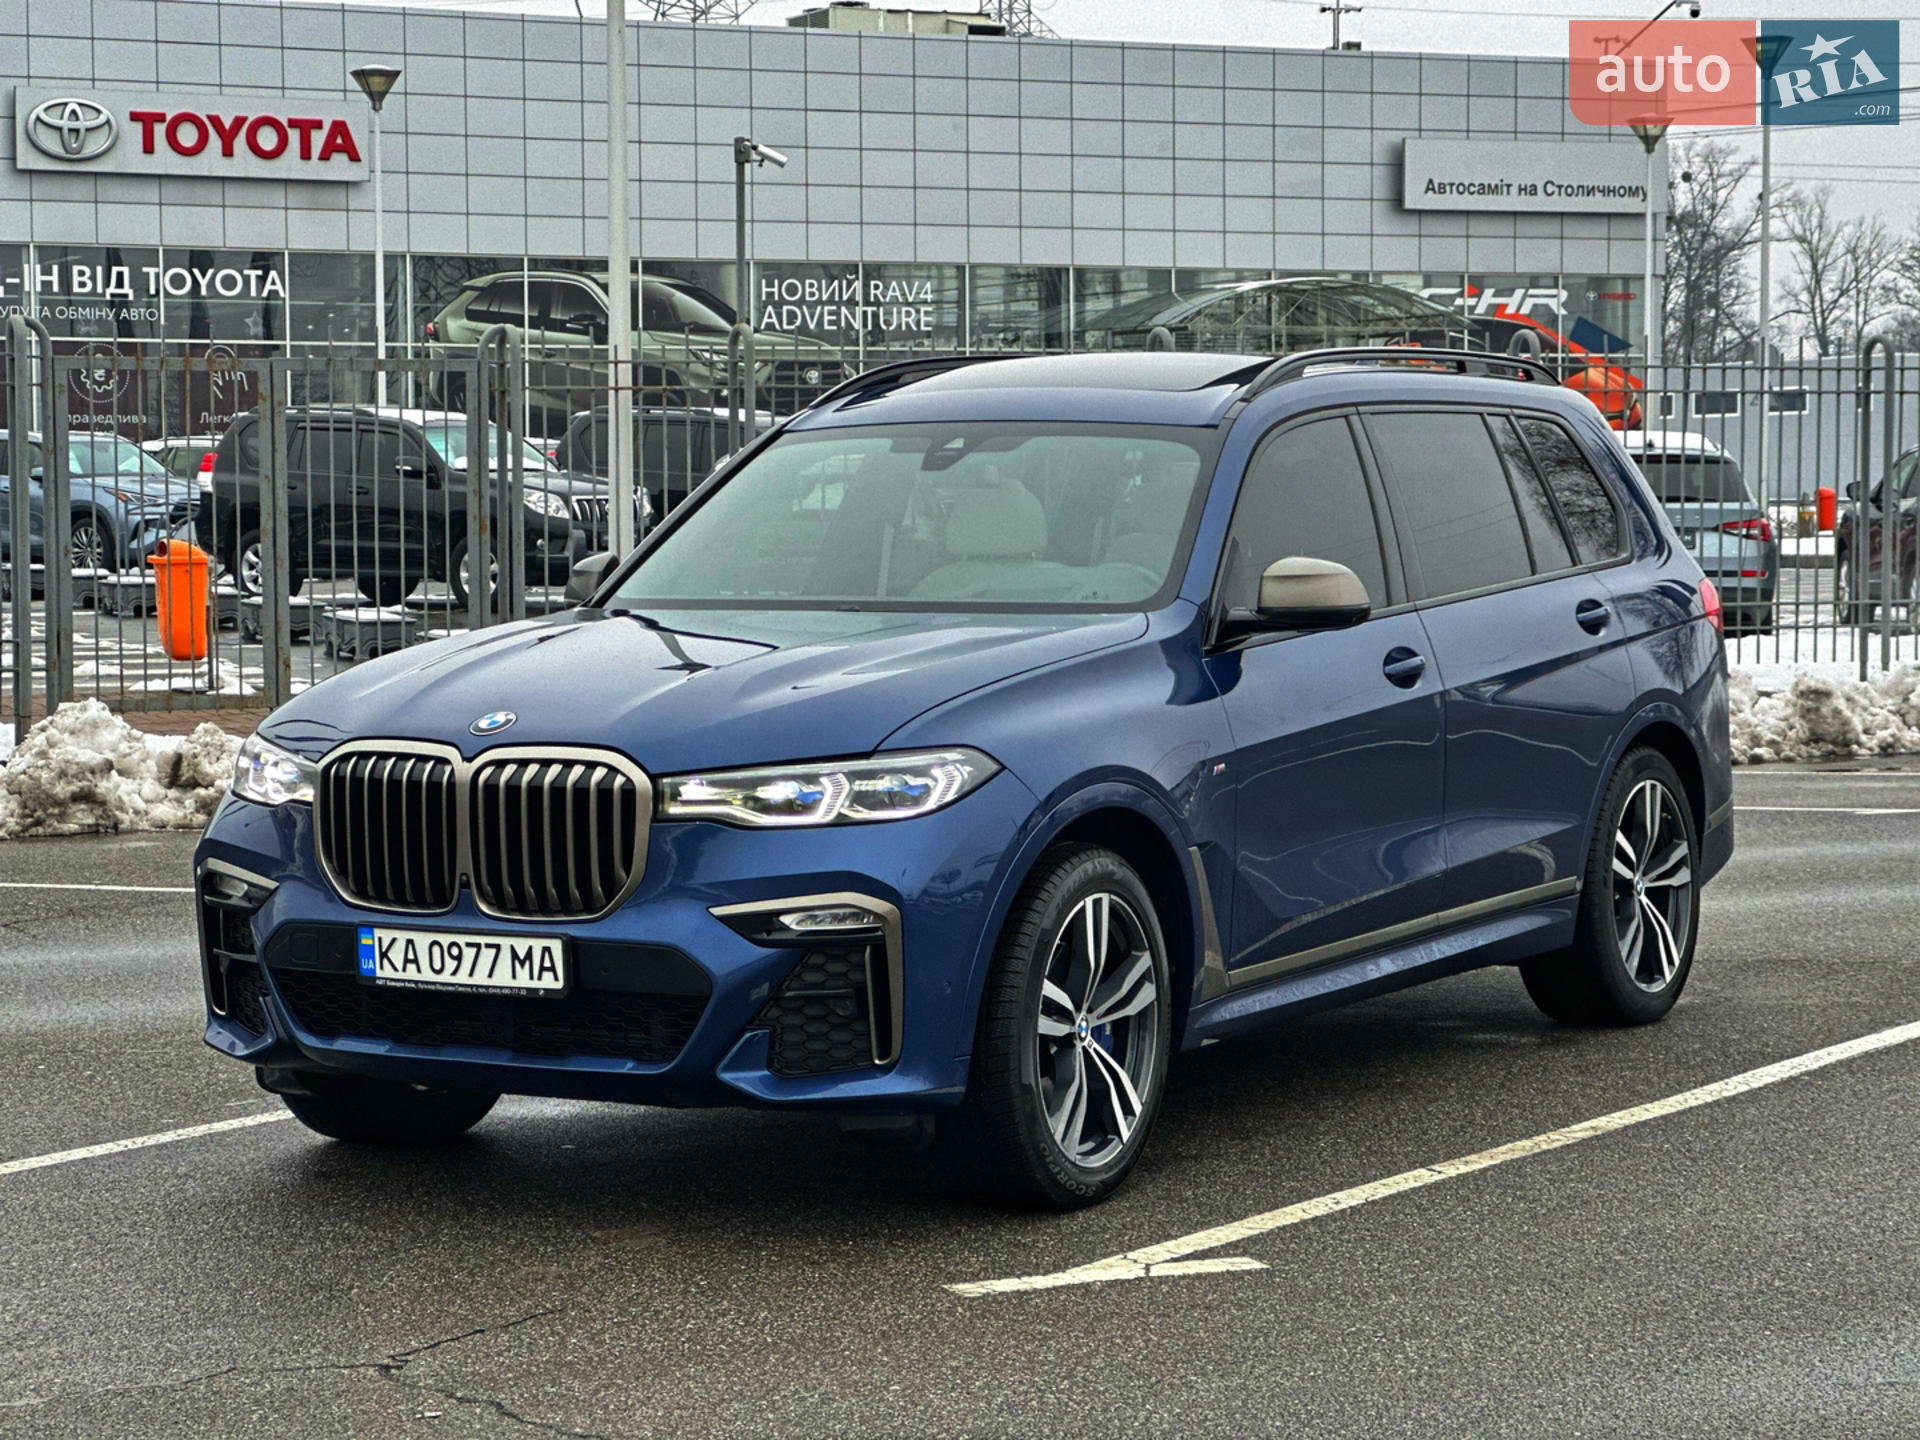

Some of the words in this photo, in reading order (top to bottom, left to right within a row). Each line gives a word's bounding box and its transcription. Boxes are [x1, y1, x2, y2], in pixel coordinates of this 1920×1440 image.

[129, 110, 362, 162] TOYOTA
[1424, 178, 1514, 197] Автосаміт
[1517, 182, 1538, 197] на
[1543, 180, 1647, 202] Столичному
[72, 265, 134, 300] ВІД
[142, 266, 286, 298] TOYOTA
[761, 274, 859, 302] НОВИЙ
[869, 280, 934, 303] RAV4
[55, 306, 117, 320] ОБМІНУ
[120, 308, 159, 321] АВТО
[760, 305, 934, 331] ADVENTURE
[362, 957, 375, 970] UA
[378, 936, 422, 974] KA
[428, 939, 502, 978] 0977
[510, 944, 560, 982] MA
